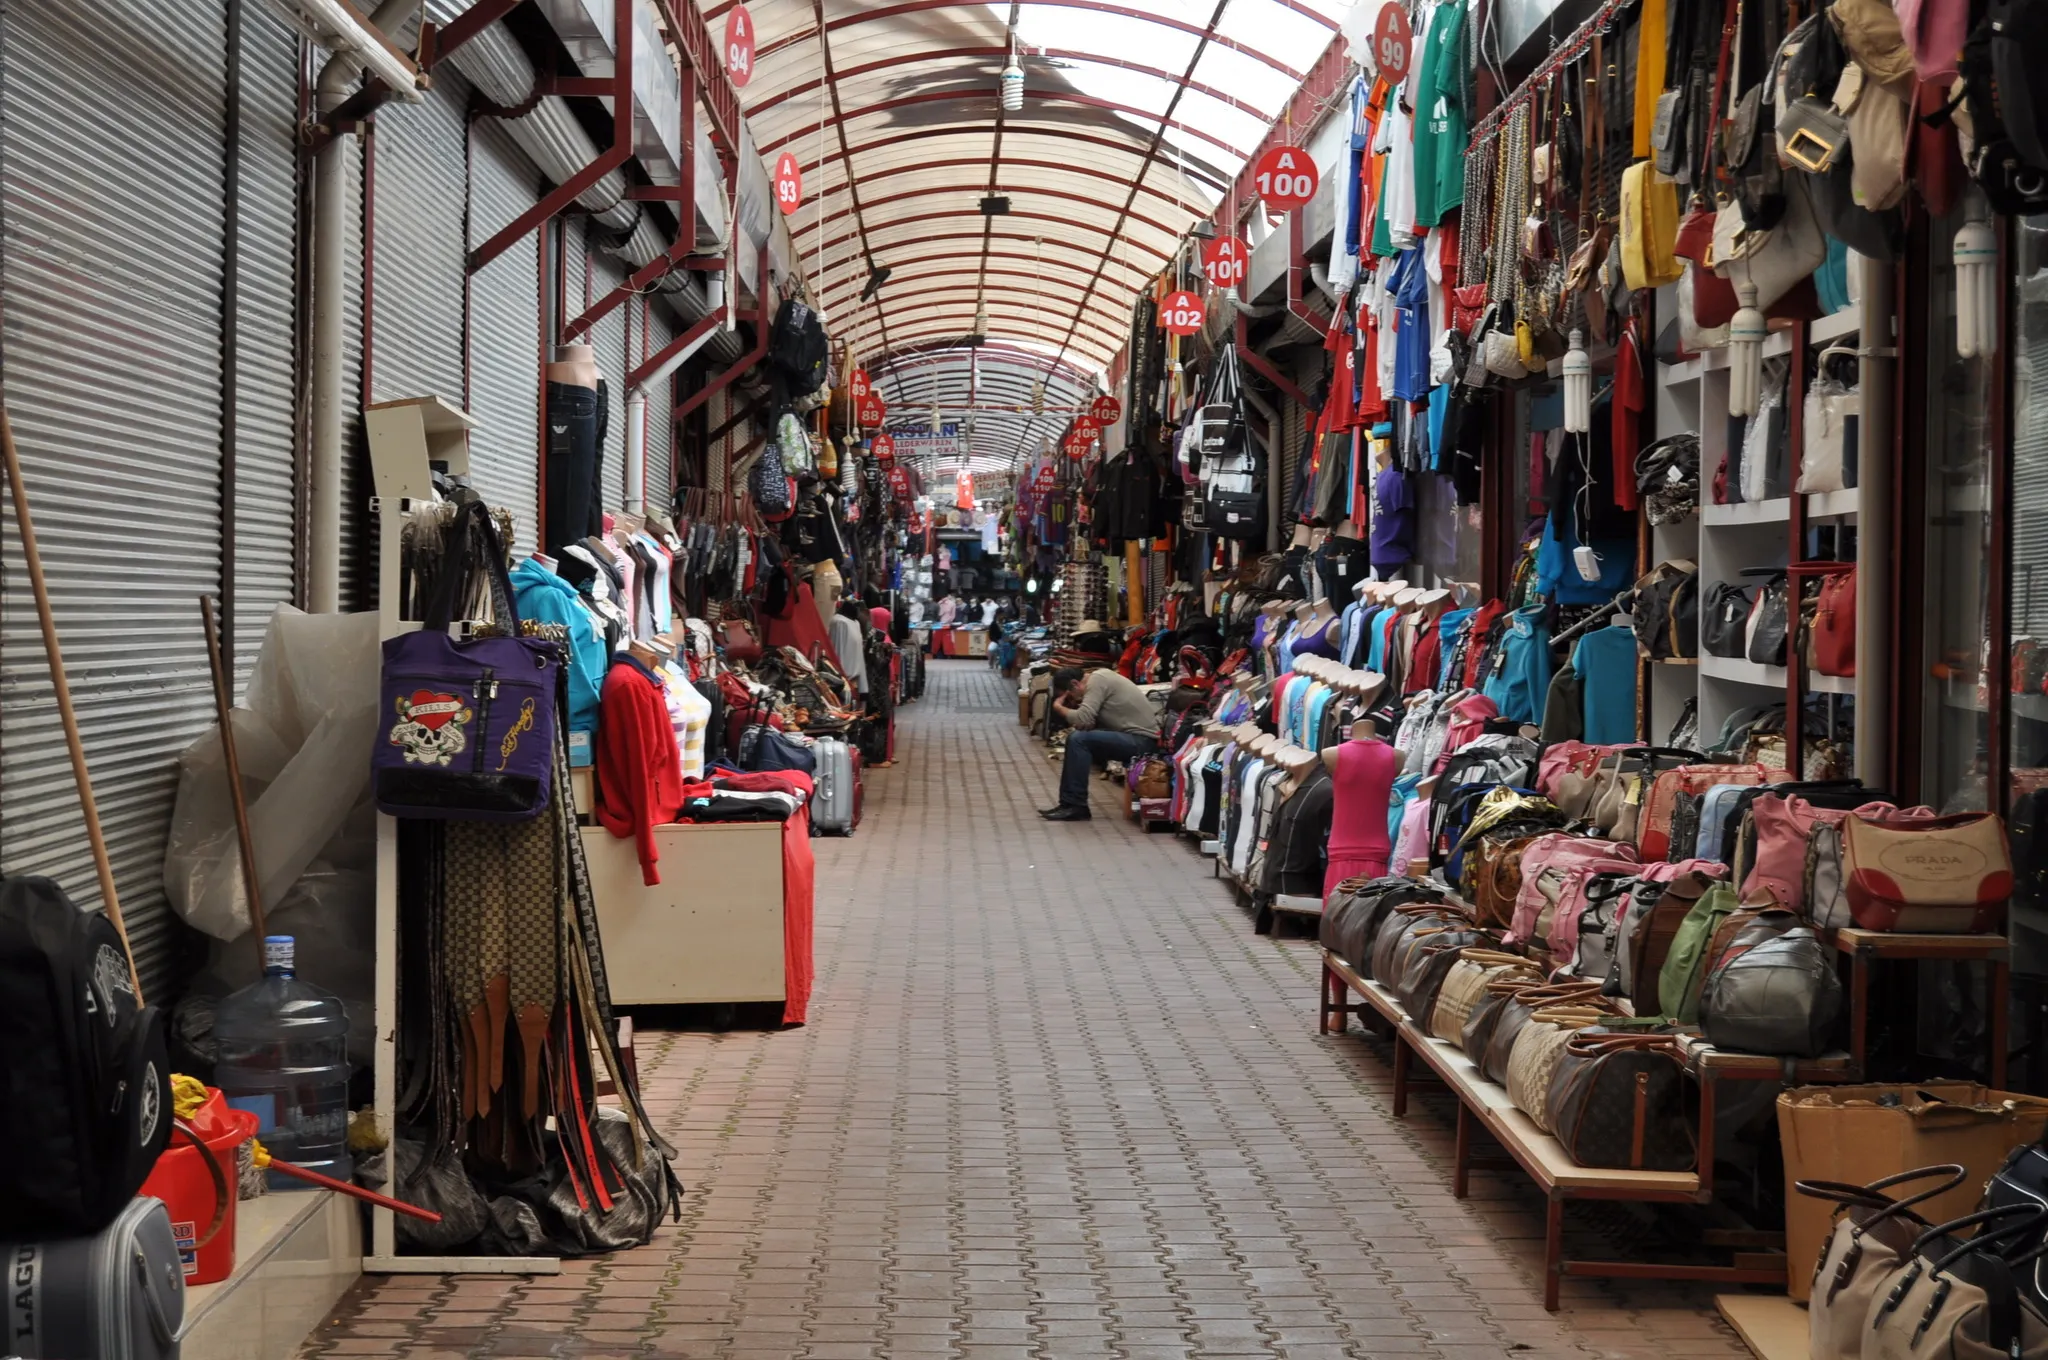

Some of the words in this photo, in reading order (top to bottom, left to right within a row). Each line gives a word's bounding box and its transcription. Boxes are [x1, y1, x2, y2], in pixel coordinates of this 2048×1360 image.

[735, 16, 745, 37] A
[1388, 13, 1399, 34] A
[730, 43, 748, 75] 94
[1381, 37, 1404, 71] 99
[1277, 153, 1296, 169] A
[782, 160, 792, 176] A
[1256, 172, 1312, 197] 100
[779, 180, 797, 203] 93
[1219, 242, 1232, 255] A
[1206, 259, 1243, 279] 101
[1176, 295, 1190, 307] A
[1162, 309, 1202, 327] 102
[855, 373, 862, 382] A
[852, 383, 866, 396] 89
[866, 400, 875, 409] A
[1102, 399, 1111, 407] A
[862, 410, 879, 421] 88
[1093, 408, 1119, 421] 105
[1082, 419, 1091, 427] A
[1073, 428, 1099, 438] 106
[879, 436, 886, 444] A
[874, 444, 890, 455] 86
[1065, 444, 1087, 455] 107
[1040, 475, 1054, 483] 109
[1052, 503, 1065, 523] 10
[1905, 856, 1963, 864] PRADA
